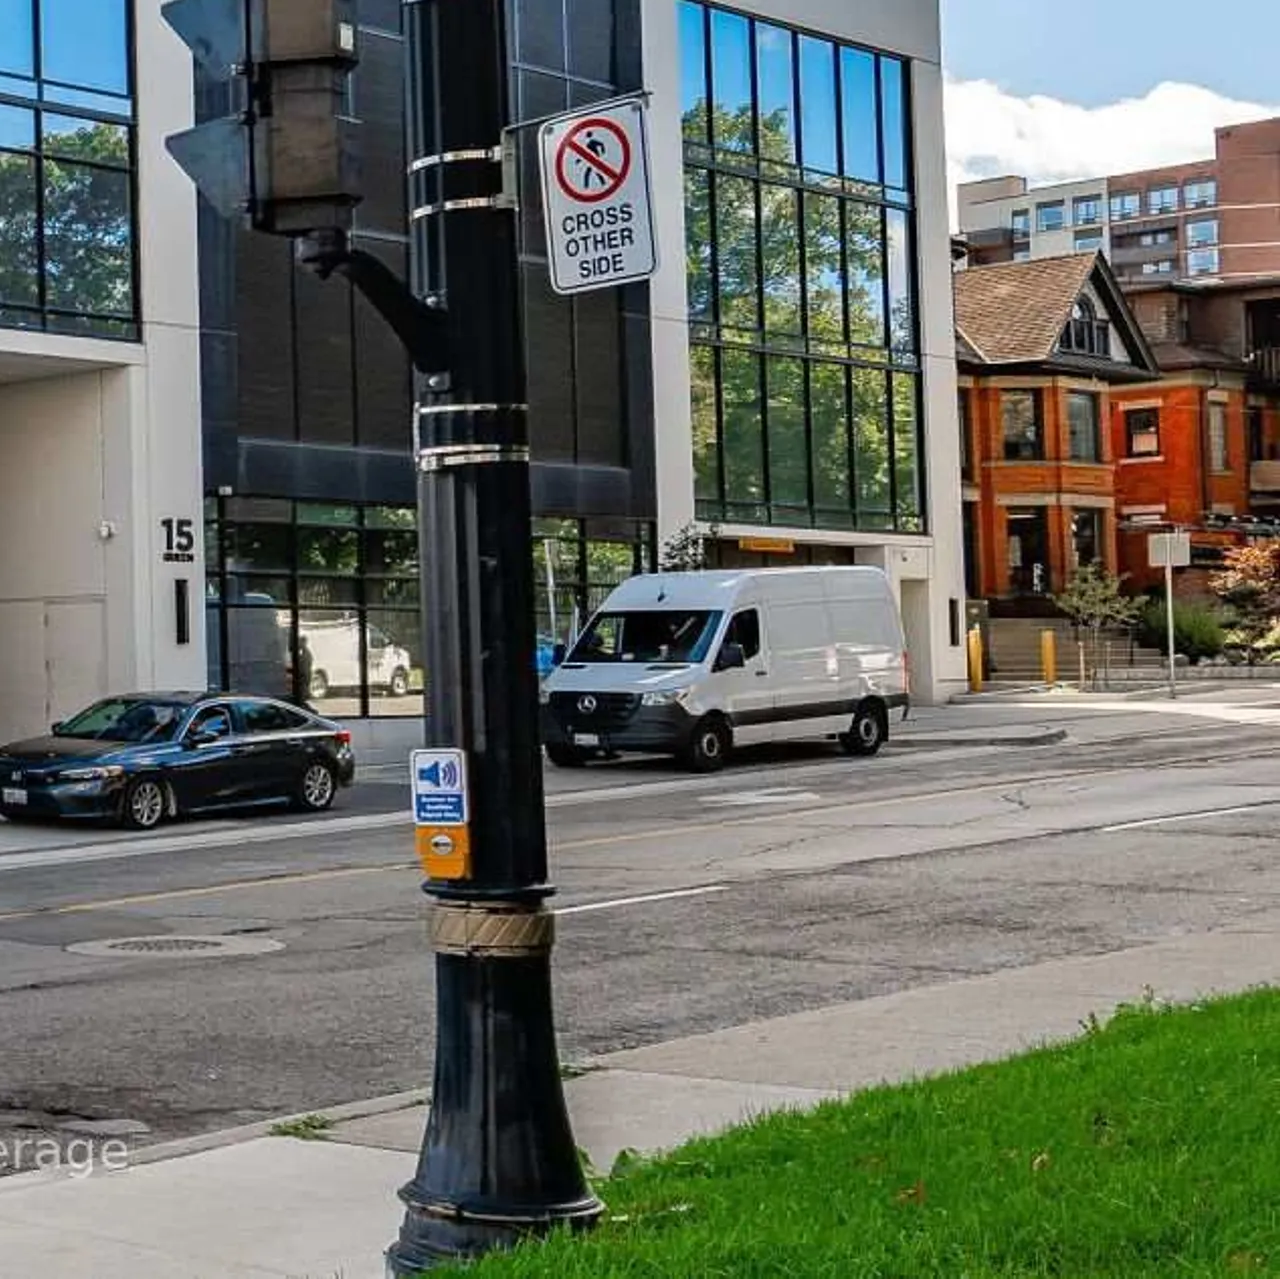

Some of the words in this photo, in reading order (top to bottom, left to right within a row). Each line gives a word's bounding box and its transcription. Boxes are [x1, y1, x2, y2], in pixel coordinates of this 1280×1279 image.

[561, 202, 634, 235] CROSS
[565, 227, 635, 257] OTHER
[578, 253, 625, 279] SIDE
[161, 517, 194, 552] 15
